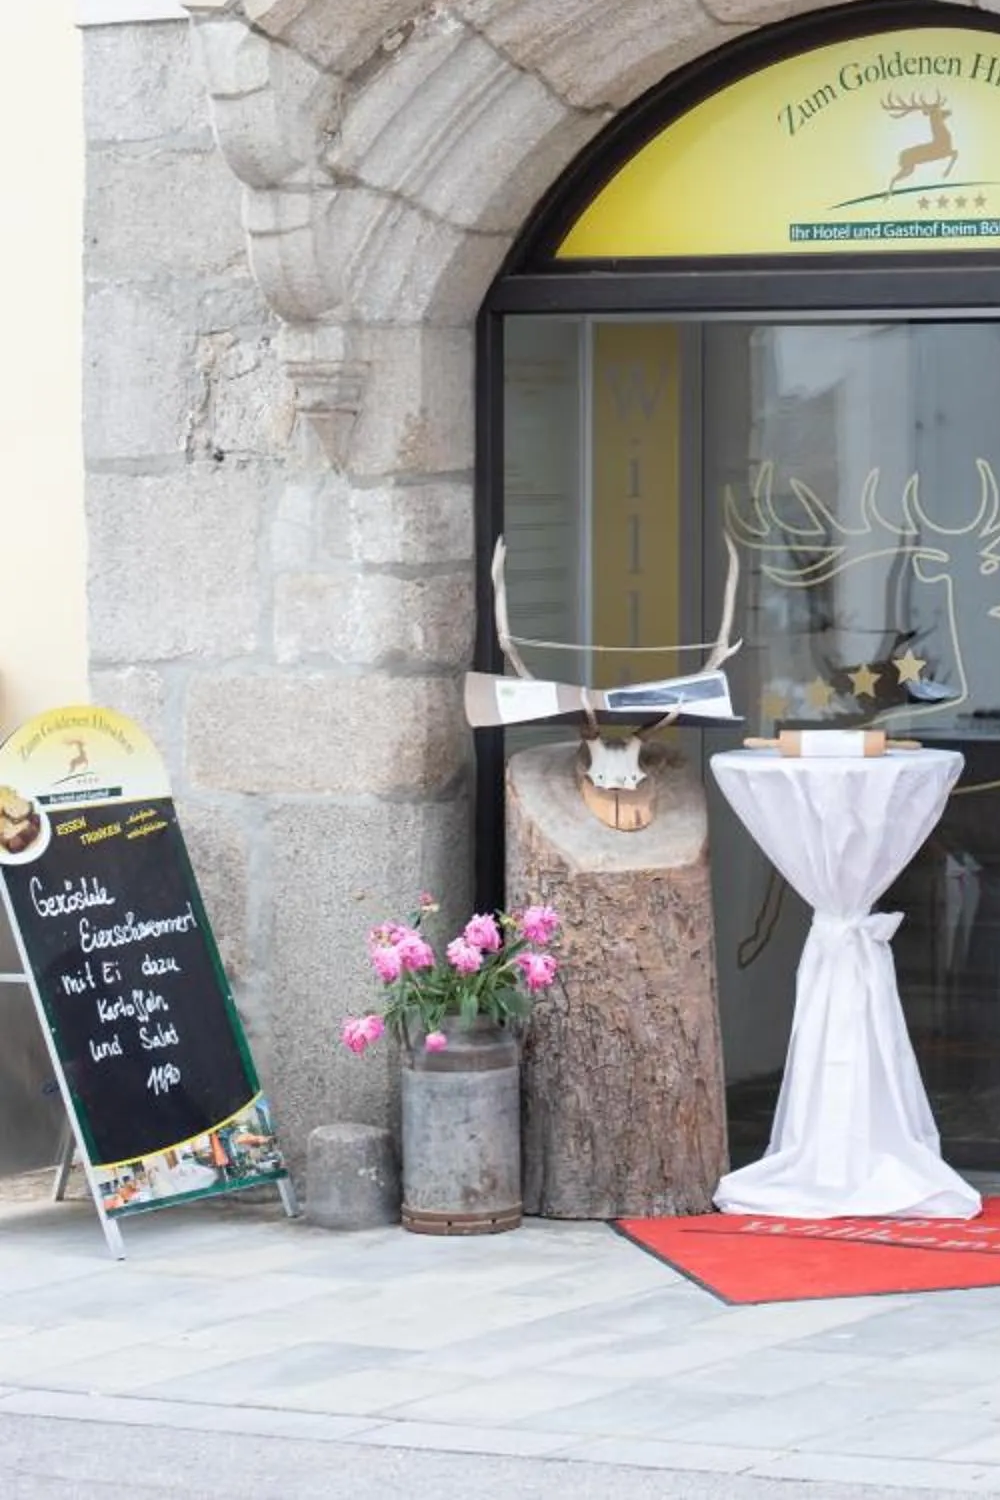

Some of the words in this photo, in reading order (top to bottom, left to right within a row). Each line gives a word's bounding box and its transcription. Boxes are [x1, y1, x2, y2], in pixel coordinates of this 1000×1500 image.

[777, 83, 838, 136] Zum
[839, 51, 962, 92] Goldenen
[791, 224, 811, 240] Ihr
[812, 223, 850, 240] Hotel
[852, 223, 882, 239] und
[883, 220, 941, 238] Gasthof
[941, 219, 977, 236] beim
[102, 961, 122, 984] Ei
[141, 953, 182, 976] dazu
